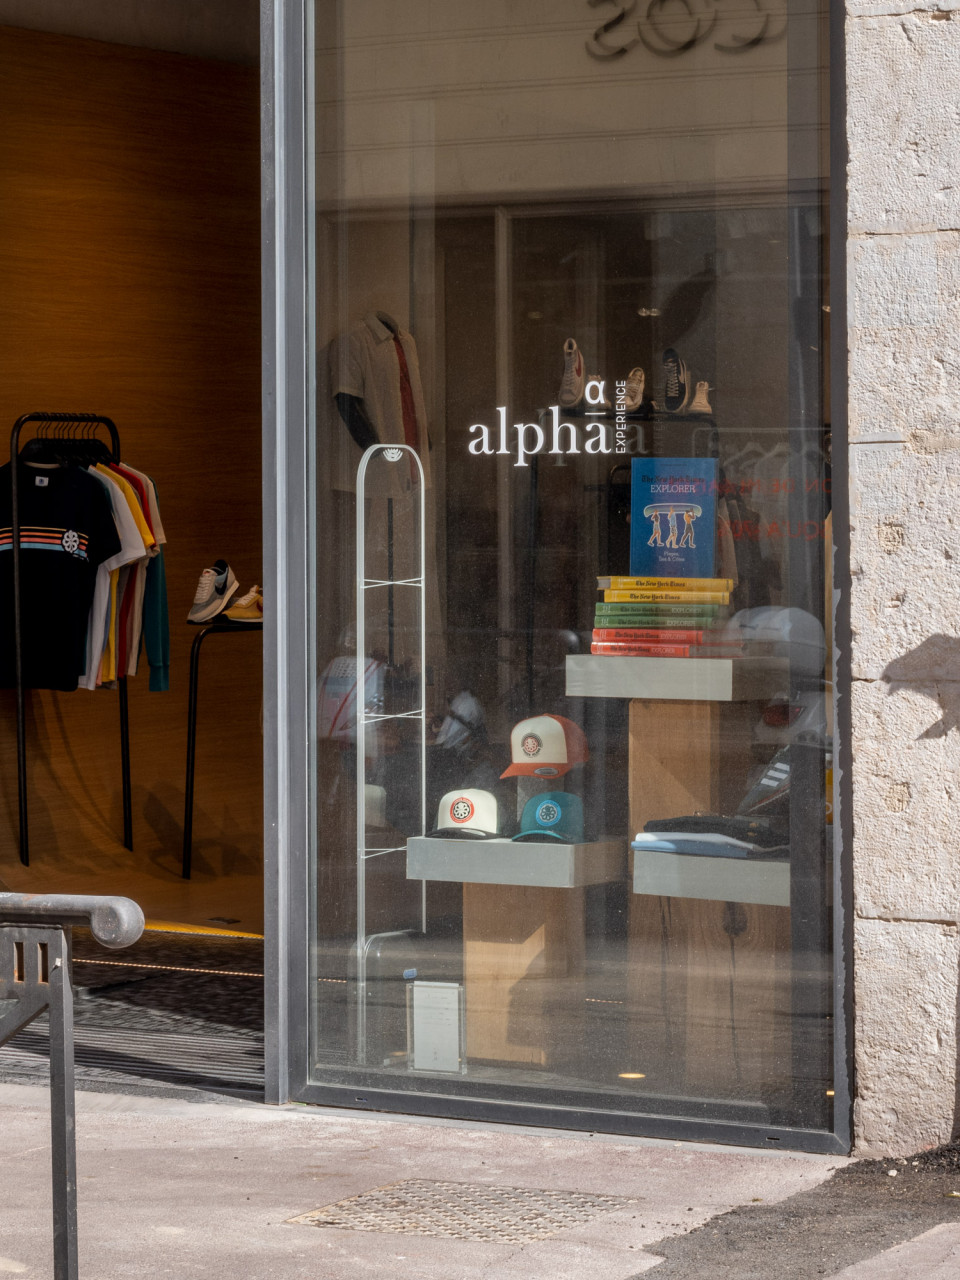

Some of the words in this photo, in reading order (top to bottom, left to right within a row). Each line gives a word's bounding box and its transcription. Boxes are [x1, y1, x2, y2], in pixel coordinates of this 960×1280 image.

[468, 406, 612, 467] alpha
[615, 380, 627, 454] EXPERIENCE
[650, 485, 696, 493] EXPLORER
